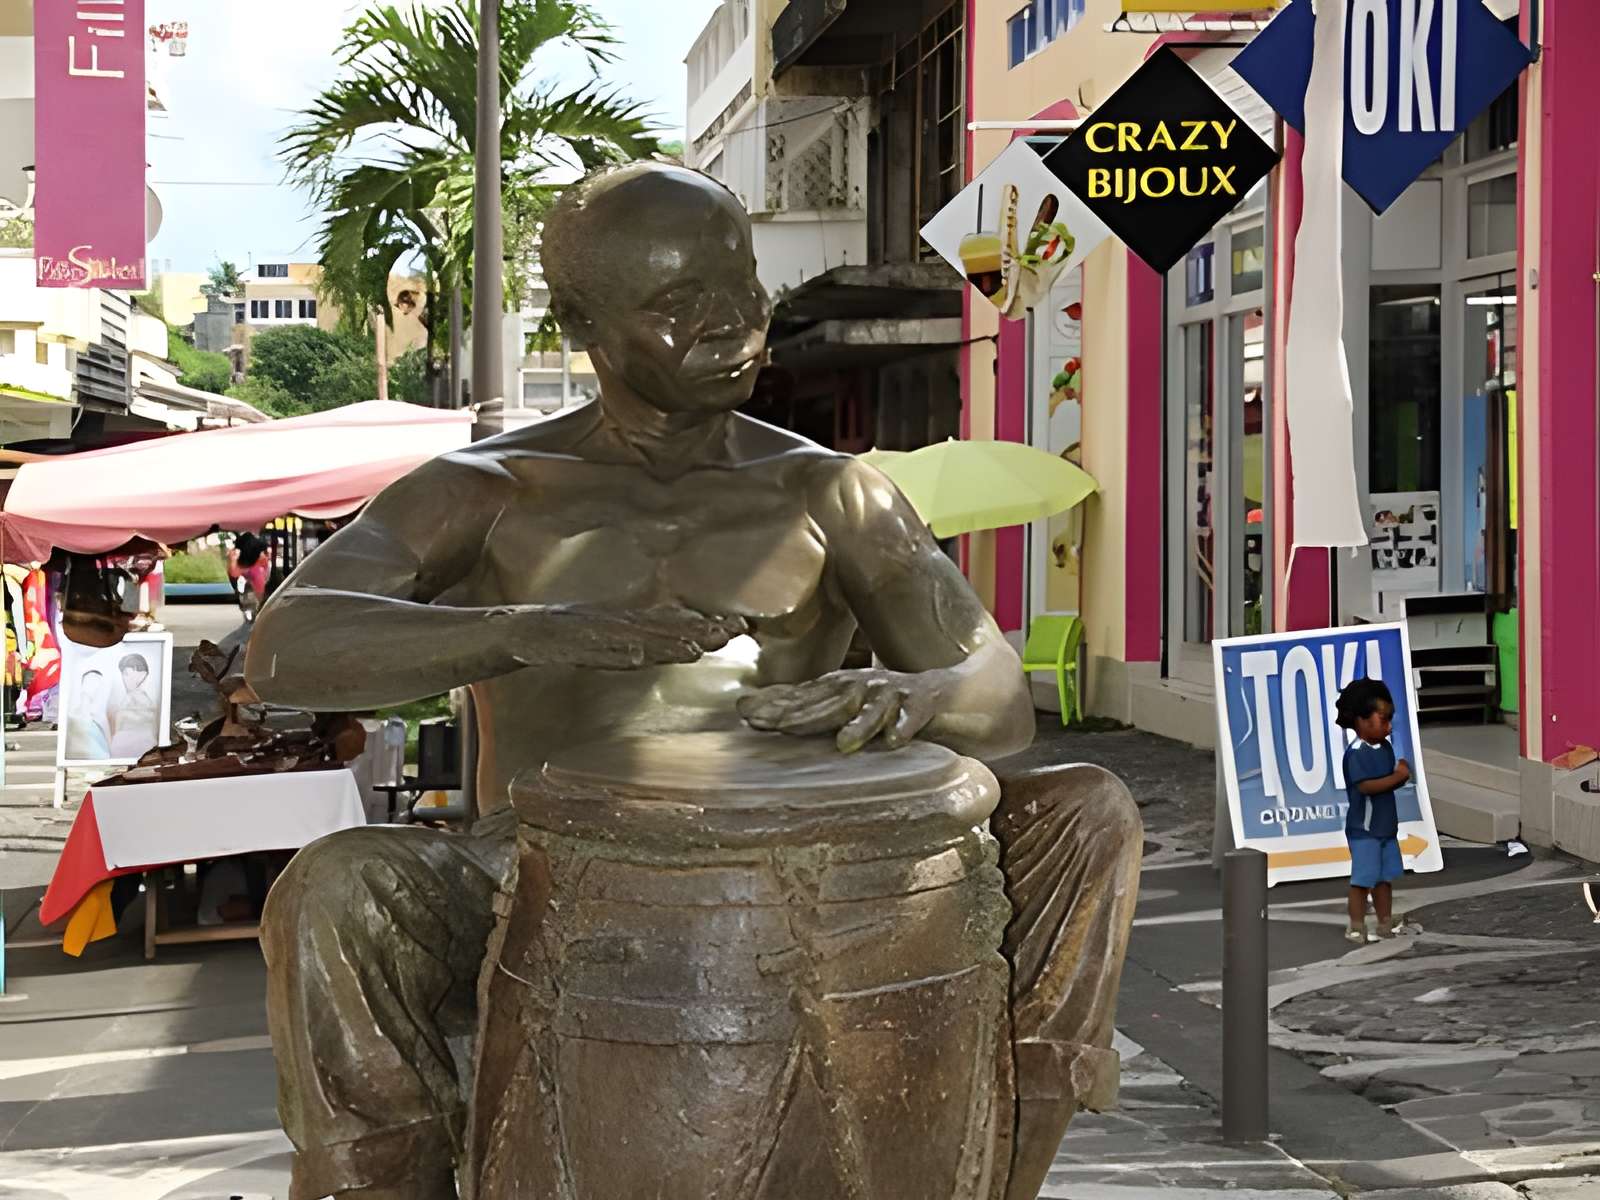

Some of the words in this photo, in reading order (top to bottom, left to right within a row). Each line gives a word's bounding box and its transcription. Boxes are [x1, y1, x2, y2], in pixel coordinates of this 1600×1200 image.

[1350, 0, 1457, 135] OKI
[1085, 119, 1237, 153] CRAZY
[1088, 165, 1237, 204] BIJOUX
[1241, 639, 1383, 797] TOK
